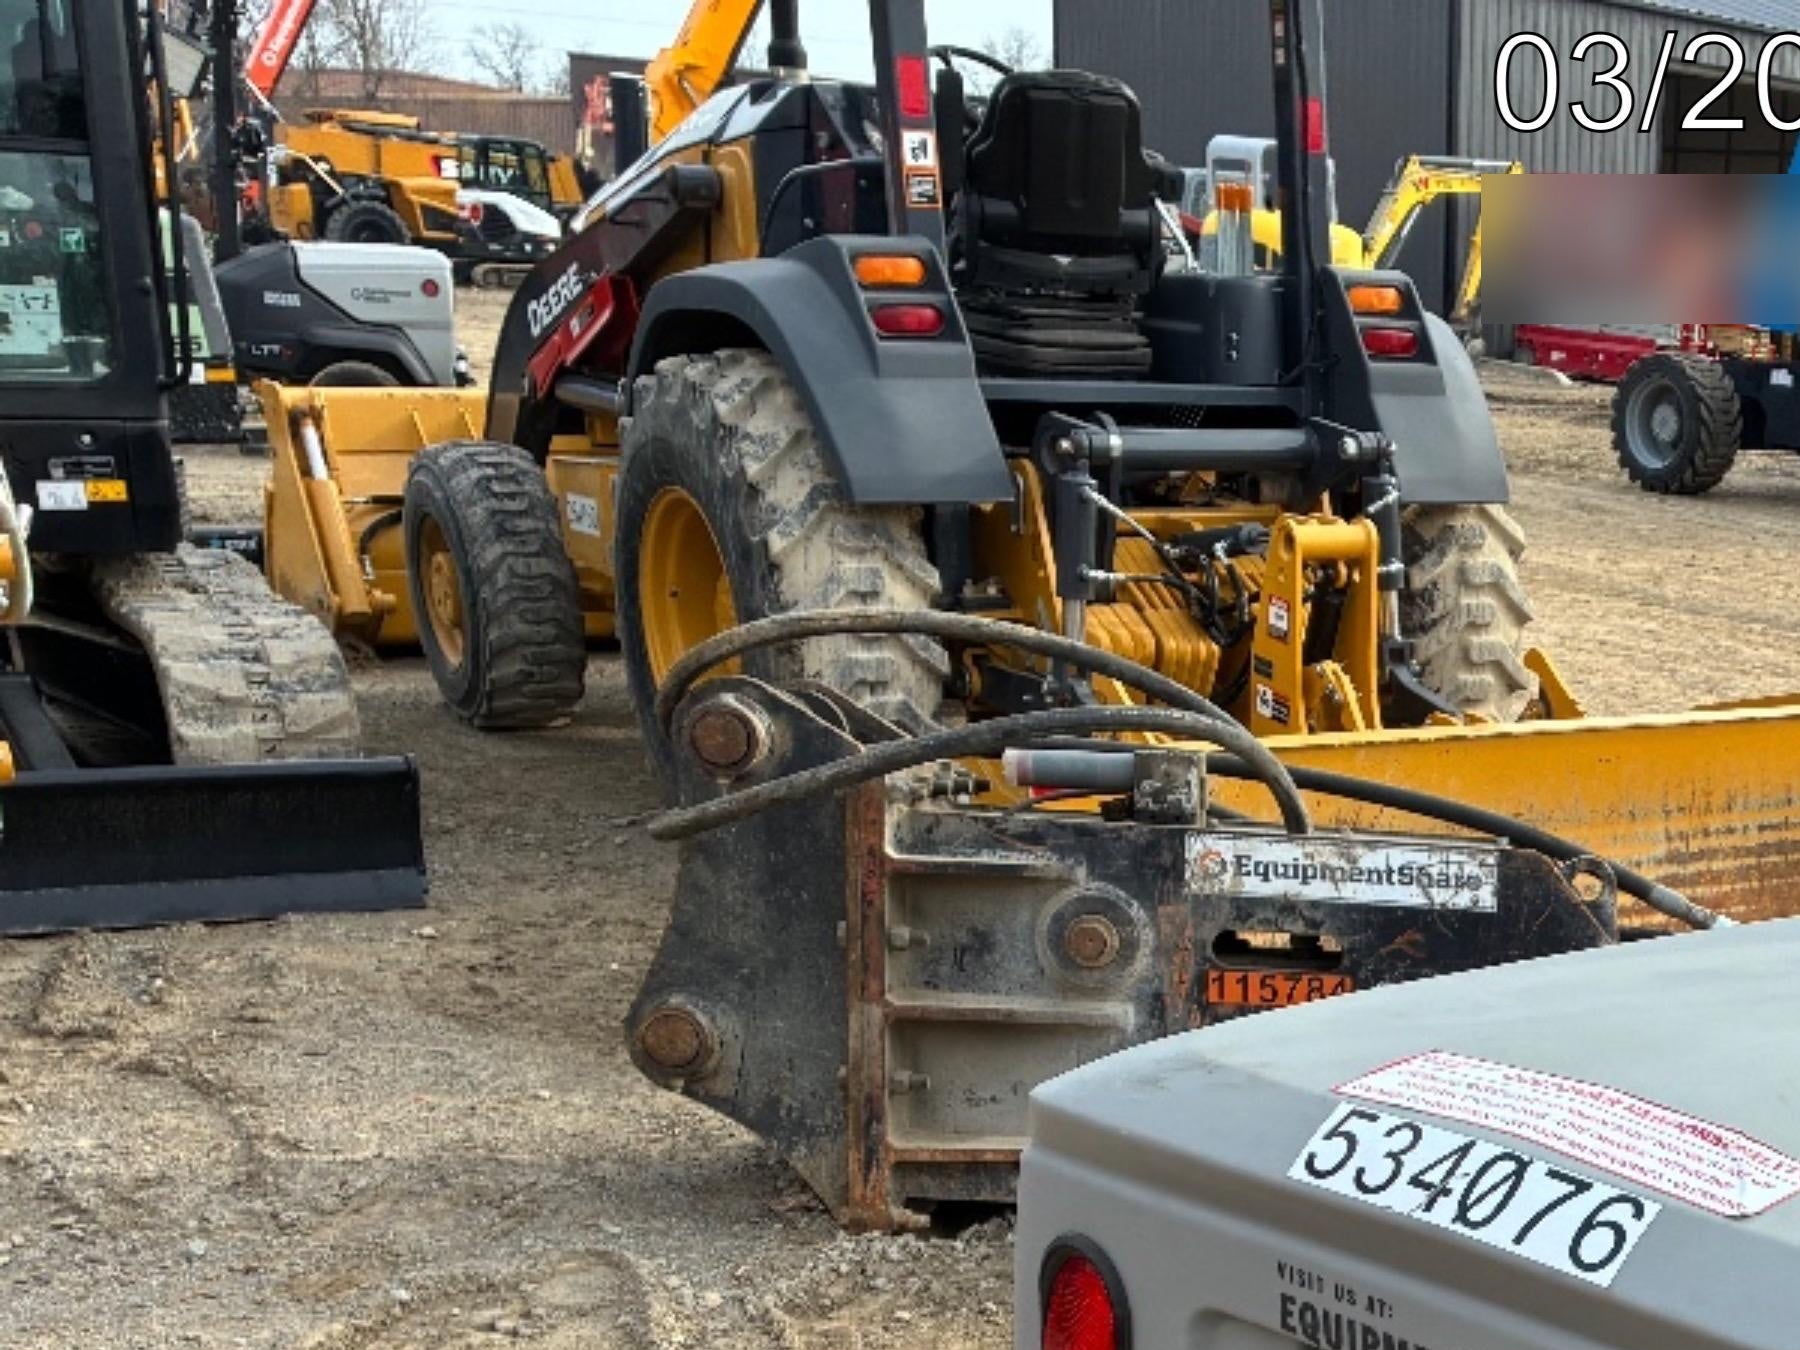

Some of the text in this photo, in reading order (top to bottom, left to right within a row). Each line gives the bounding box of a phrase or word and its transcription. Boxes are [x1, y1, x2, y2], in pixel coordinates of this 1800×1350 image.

[526, 261, 584, 338] DEERE
[1232, 853, 1484, 893] EquipmentShare
[1210, 971, 1347, 1004] 115784
[1302, 1108, 1646, 1274] 534076
[1275, 1260, 1395, 1320] VISIT US AT:
